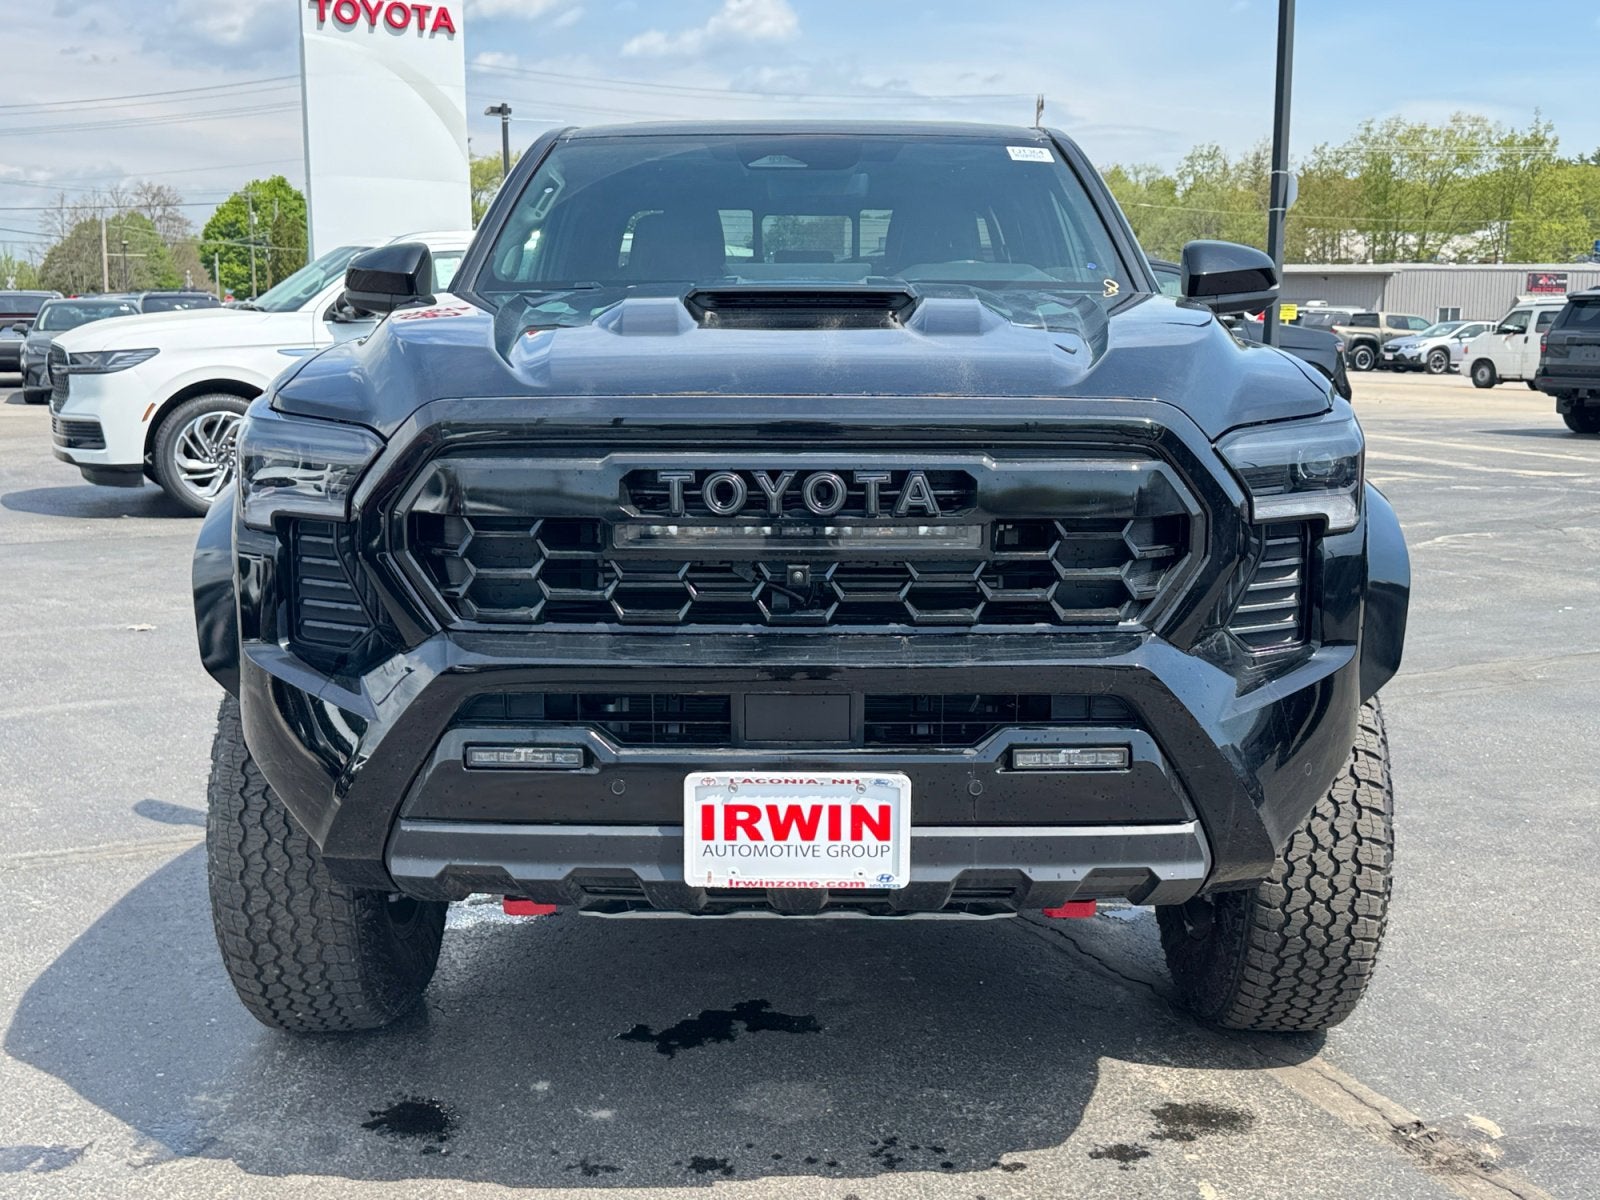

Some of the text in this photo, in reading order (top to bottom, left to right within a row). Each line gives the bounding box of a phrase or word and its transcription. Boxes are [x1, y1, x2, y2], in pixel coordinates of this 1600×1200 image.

[310, 0, 456, 34] TOYOTA
[657, 469, 942, 518] TOYOTA
[729, 778, 824, 786] LACONIA,
[701, 804, 892, 841] IRWIN
[702, 844, 891, 858] AUTOMOTIVE GROUP
